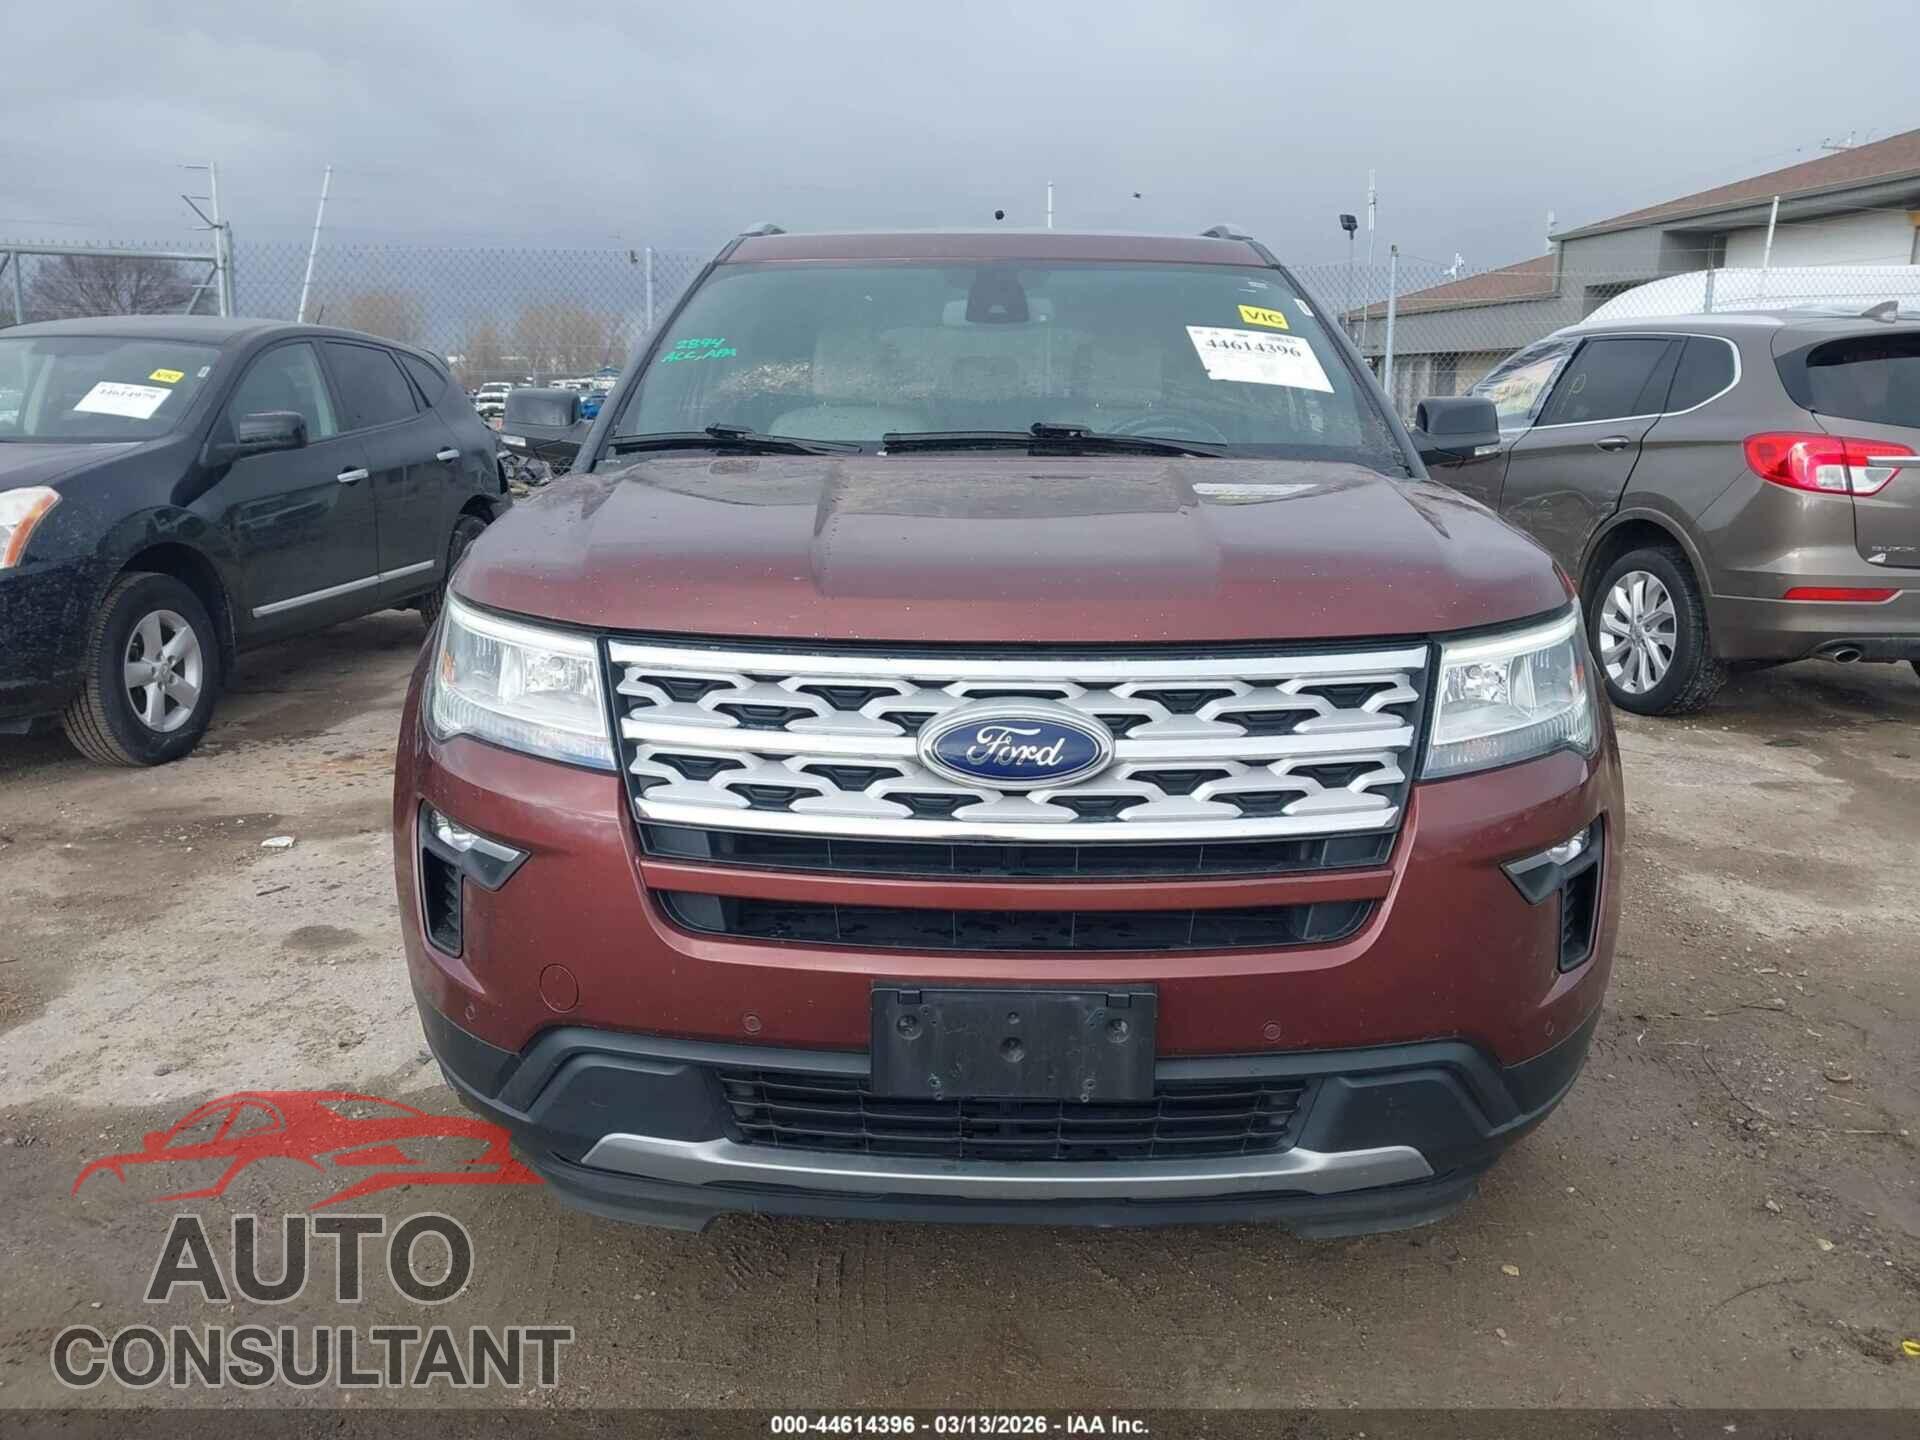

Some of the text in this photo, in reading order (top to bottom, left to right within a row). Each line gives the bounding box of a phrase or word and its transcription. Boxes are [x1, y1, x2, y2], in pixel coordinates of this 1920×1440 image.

[1244, 310, 1284, 325] VIC
[1205, 338, 1302, 357] 44614396
[966, 725, 1066, 766] Ford
